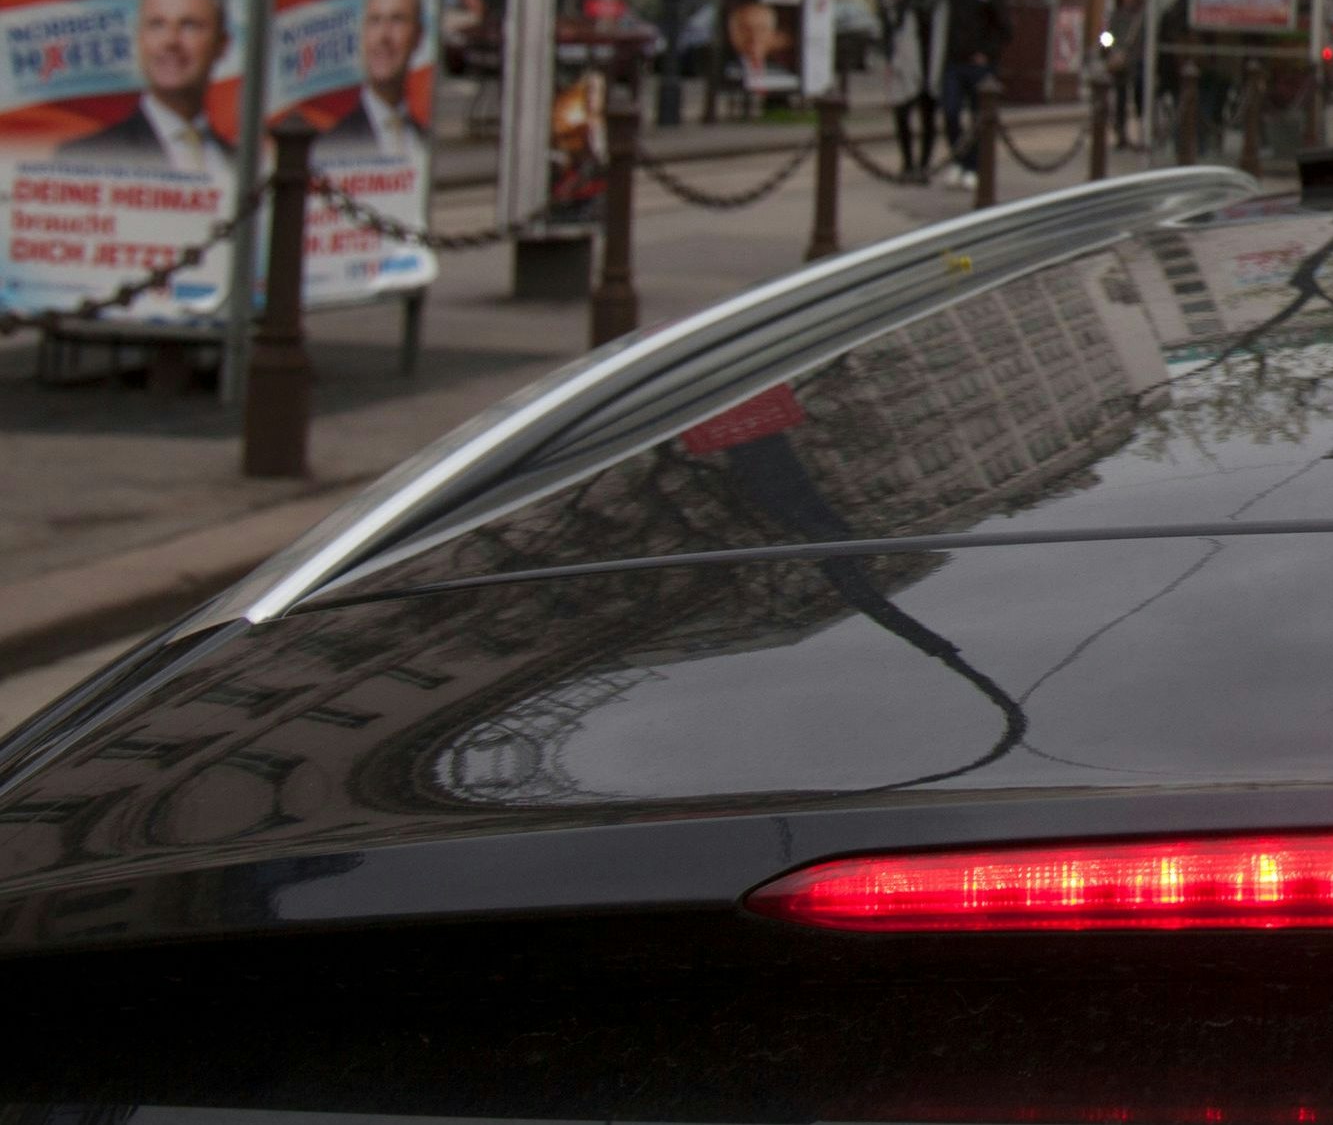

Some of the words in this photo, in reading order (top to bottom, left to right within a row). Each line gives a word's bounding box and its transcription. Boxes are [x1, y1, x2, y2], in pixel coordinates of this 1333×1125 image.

[13, 179, 100, 205] DEINE
[109, 186, 220, 213] HEIMAT
[12, 209, 116, 235] braucht
[11, 238, 84, 265] DICH
